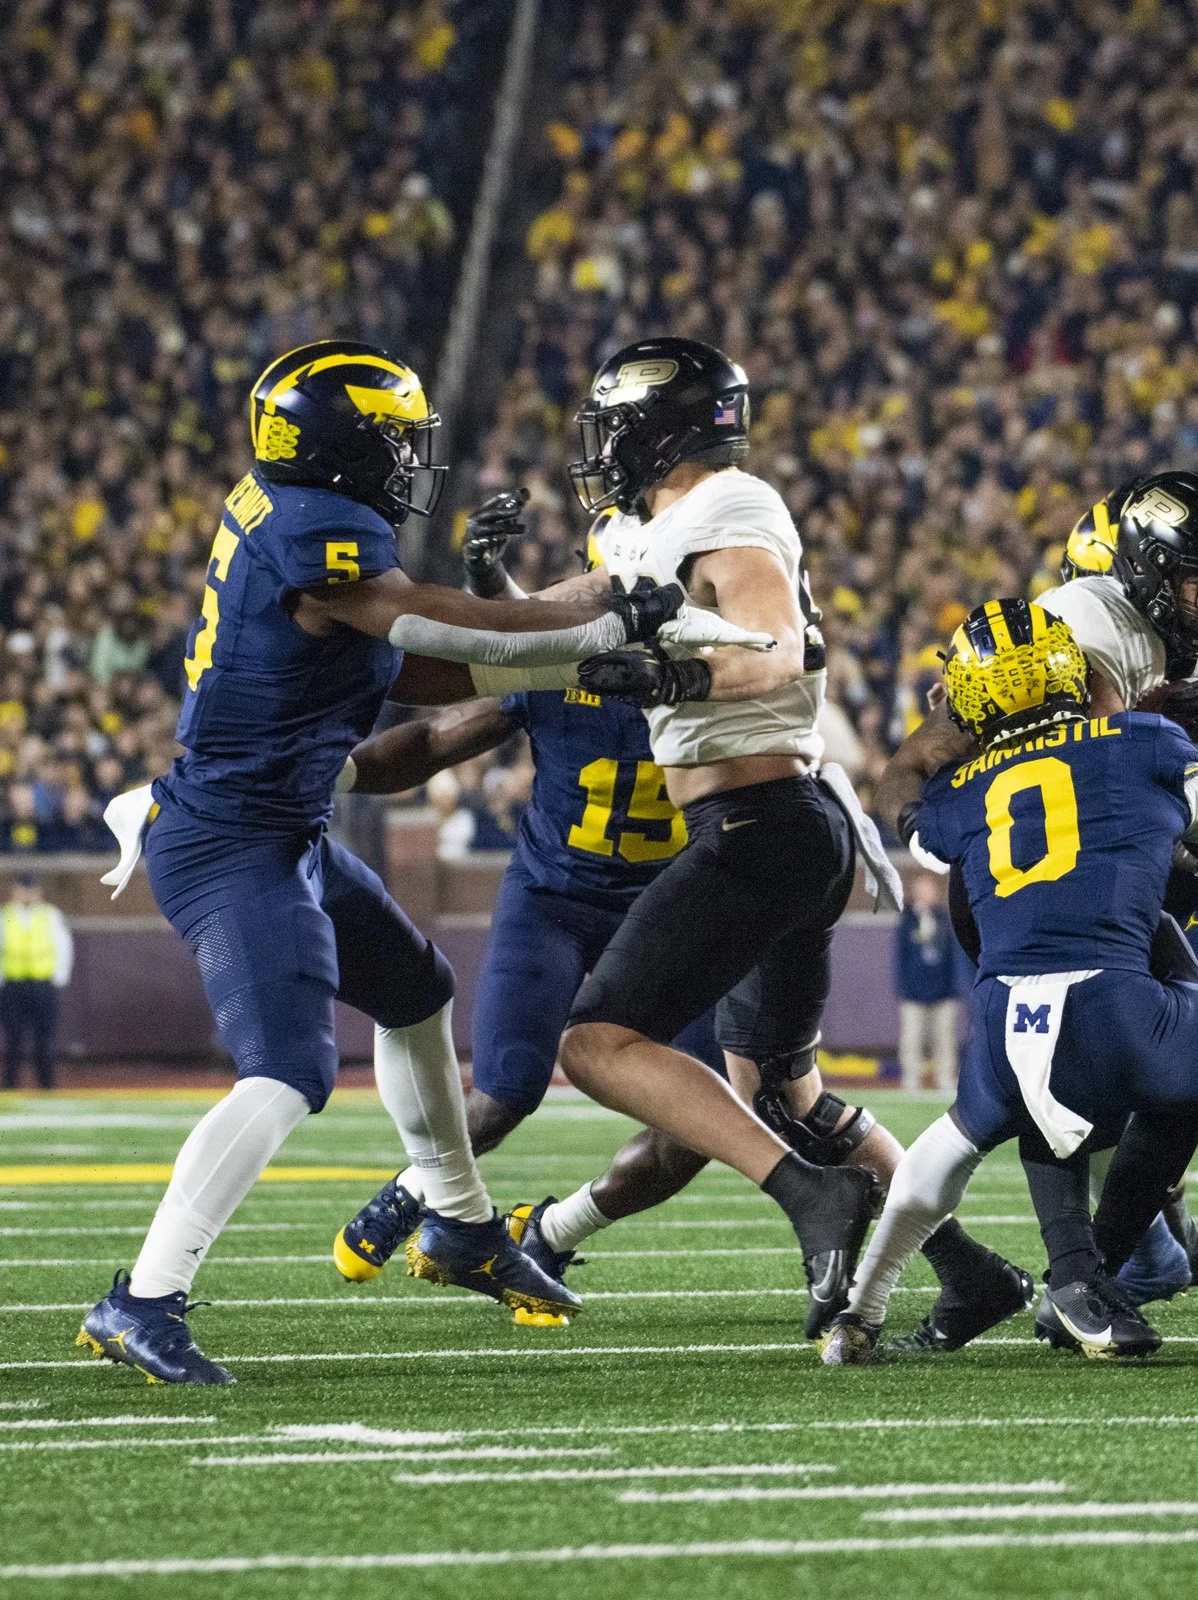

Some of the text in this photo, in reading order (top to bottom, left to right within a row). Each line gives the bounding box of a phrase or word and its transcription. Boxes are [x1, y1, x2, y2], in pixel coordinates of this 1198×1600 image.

[1125, 487, 1190, 528] P
[326, 541, 361, 585] 5
[567, 757, 689, 863] 15
[985, 756, 1081, 898] 0
[1013, 1003, 1051, 1034] M
